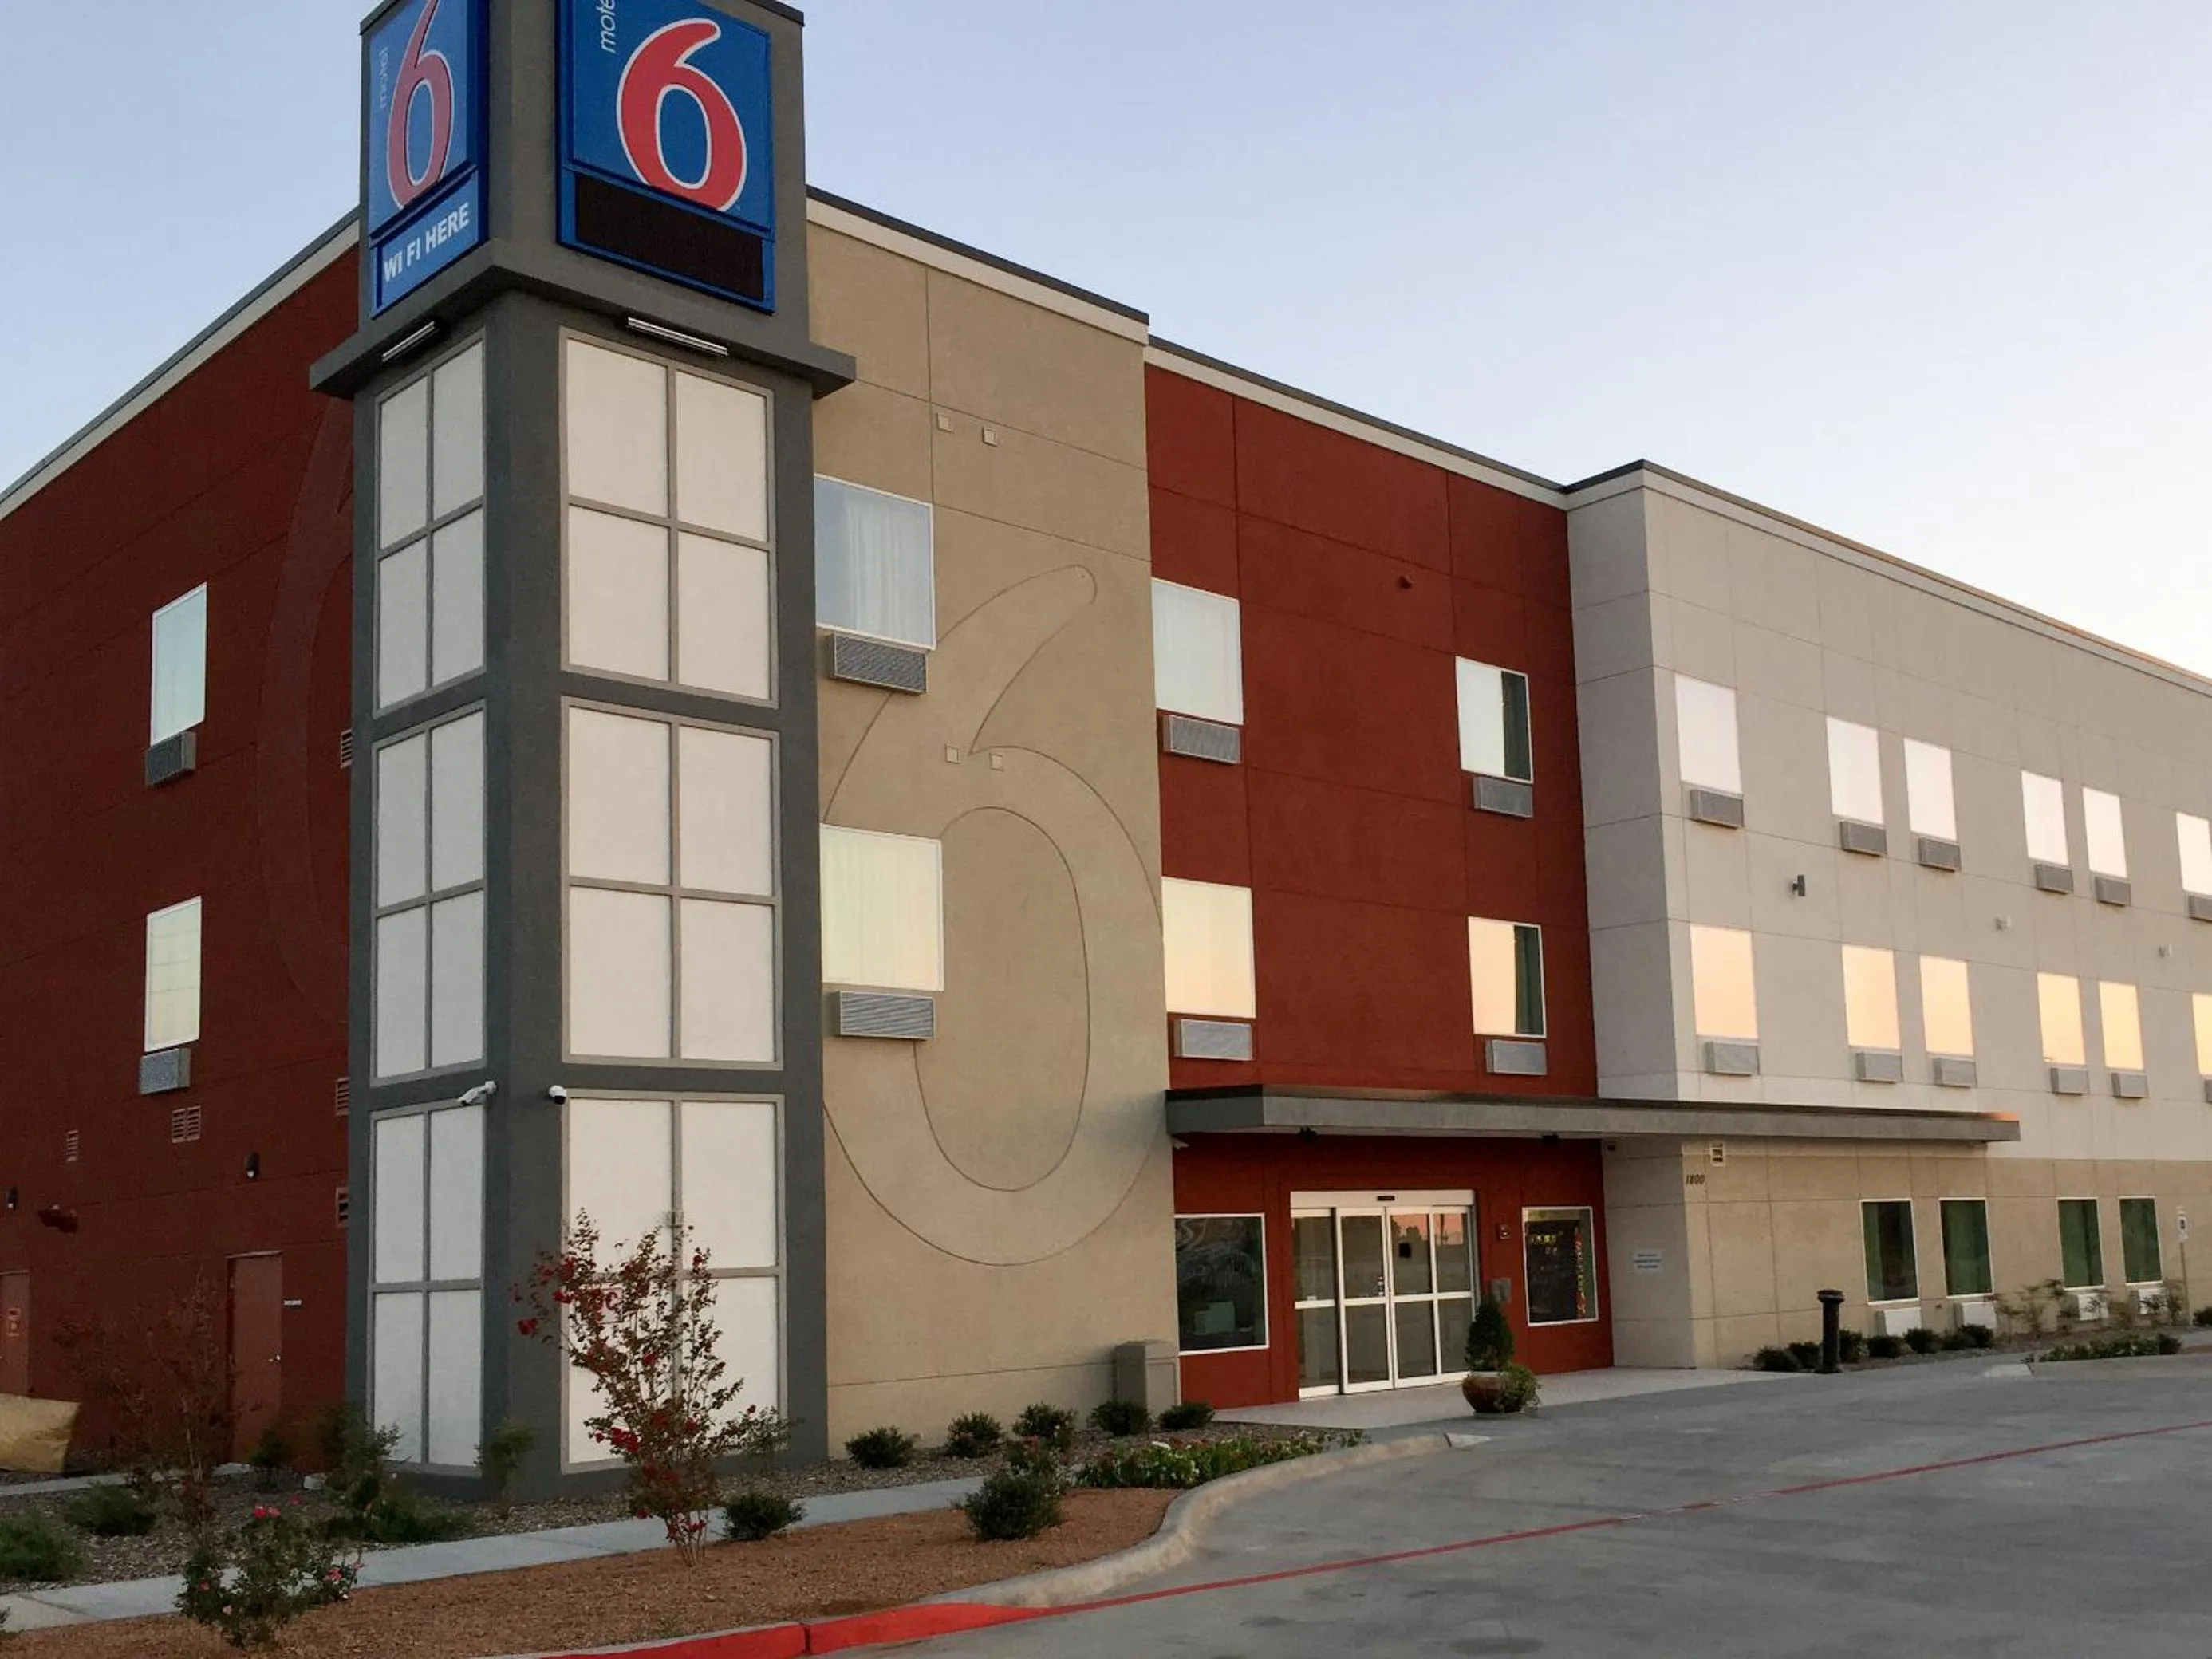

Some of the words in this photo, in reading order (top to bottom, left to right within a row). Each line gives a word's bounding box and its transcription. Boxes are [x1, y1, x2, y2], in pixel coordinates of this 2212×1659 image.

[595, 0, 617, 54] mote
[386, 0, 454, 209] 6
[617, 18, 747, 211] 6
[384, 251, 403, 282] WI
[406, 238, 420, 267] FI
[425, 202, 469, 254] HERE
[1686, 1173, 1705, 1185] 1800
